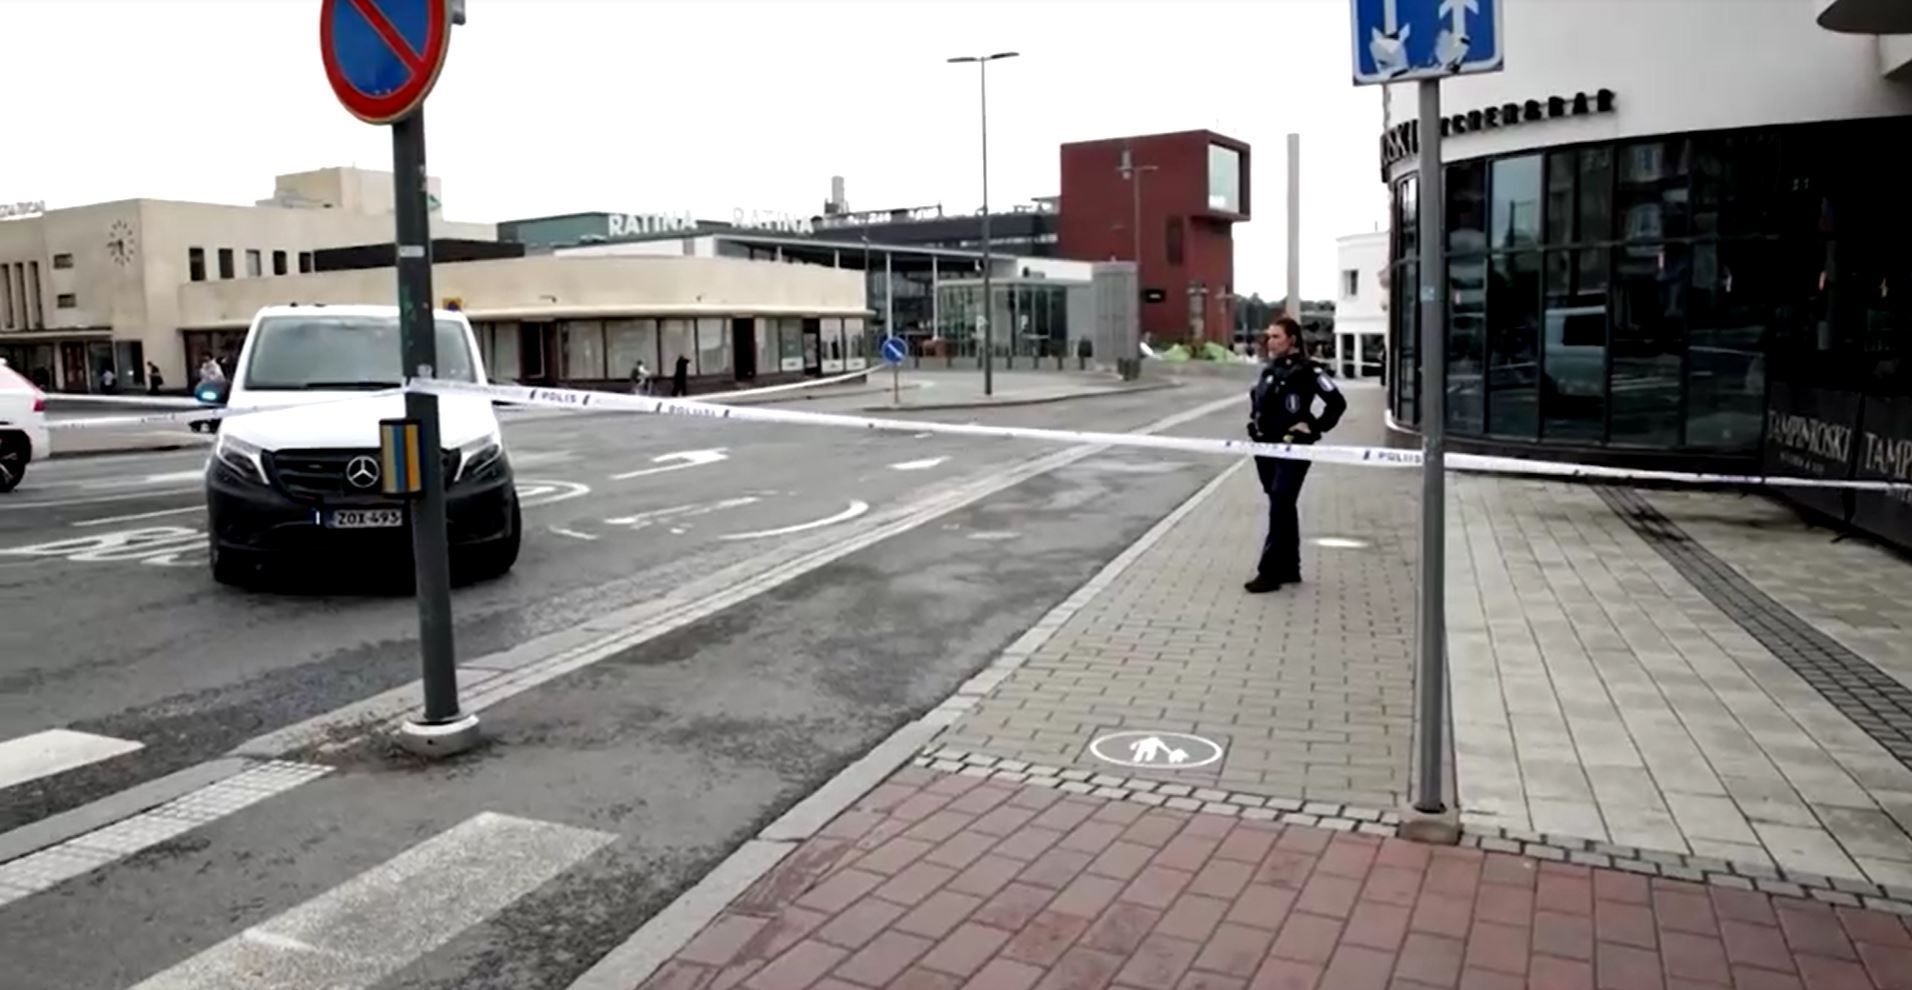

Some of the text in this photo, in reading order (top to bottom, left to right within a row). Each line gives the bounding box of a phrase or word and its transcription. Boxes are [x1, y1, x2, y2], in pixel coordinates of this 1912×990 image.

[608, 209, 698, 237] RATINA
[731, 207, 814, 235] RATINA
[541, 390, 577, 404] POLIS
